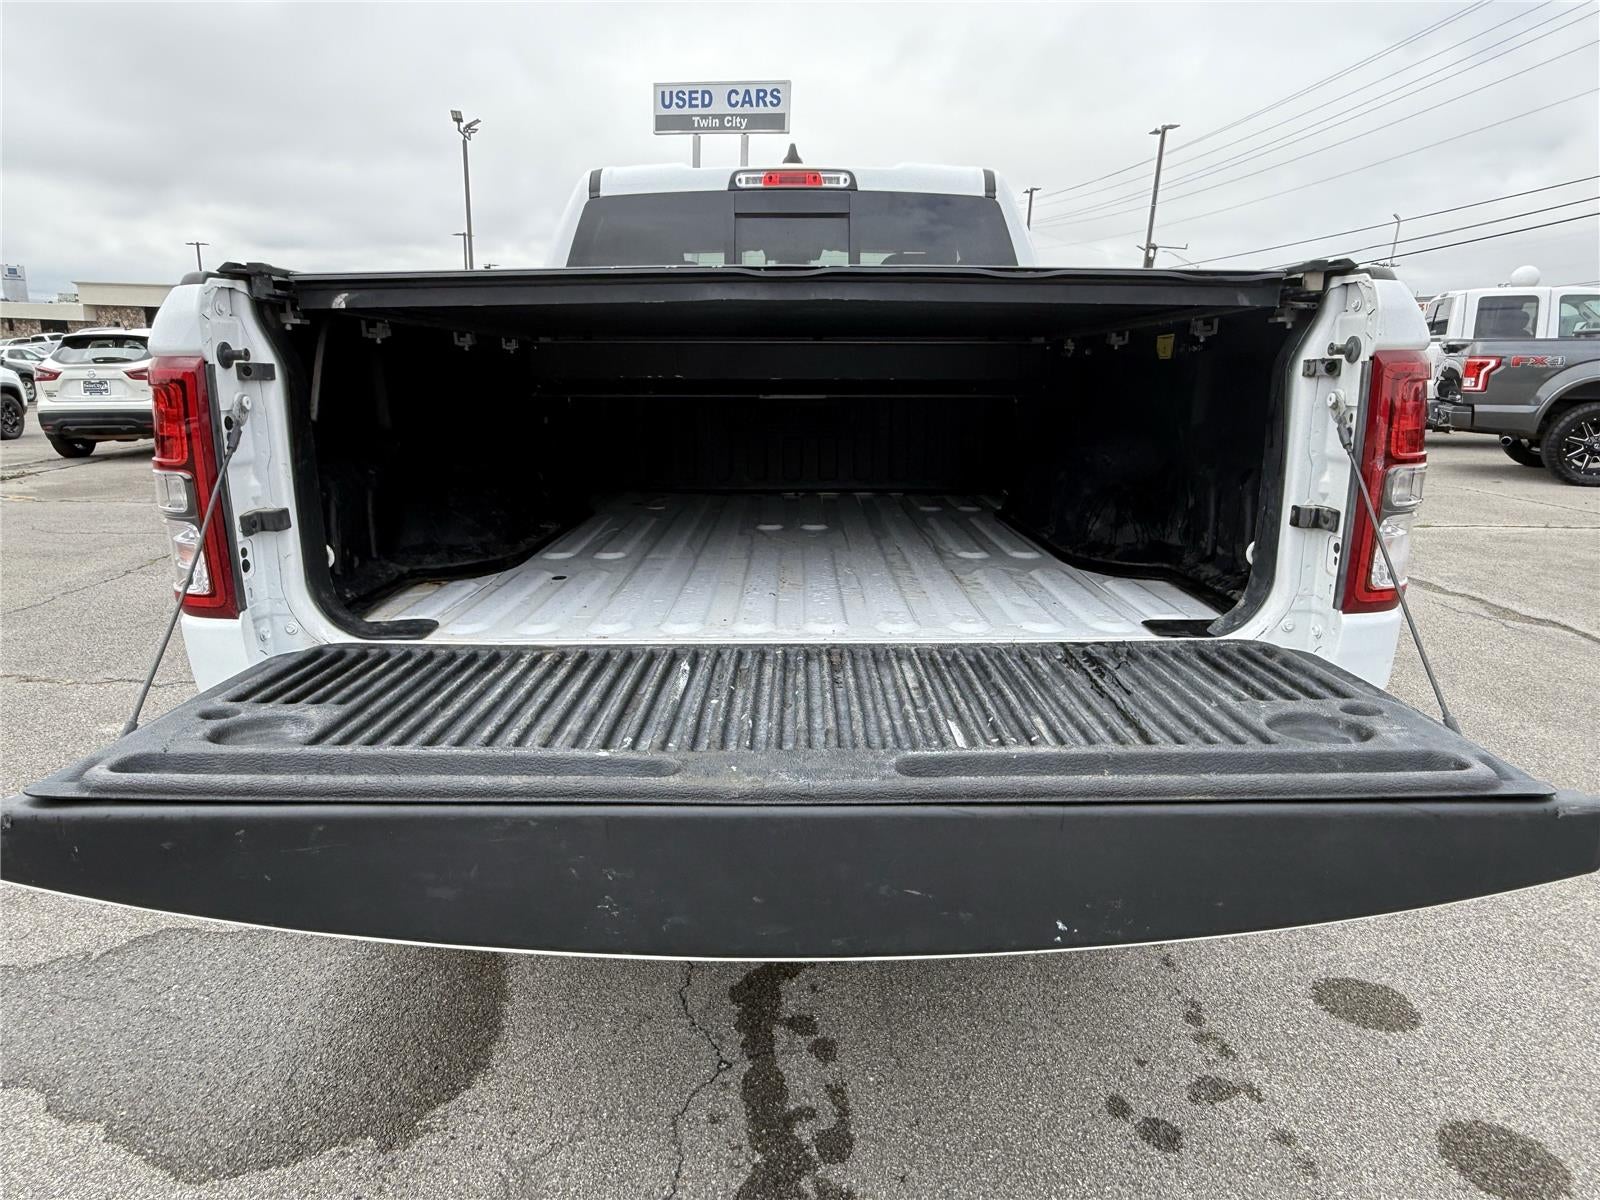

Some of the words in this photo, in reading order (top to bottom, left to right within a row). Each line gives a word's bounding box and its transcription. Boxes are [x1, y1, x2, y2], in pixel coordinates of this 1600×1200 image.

[660, 90, 713, 109] USED
[727, 88, 781, 108] CARS
[692, 116, 719, 127] Twin
[724, 116, 747, 129] City
[1511, 356, 1565, 367] FX4
